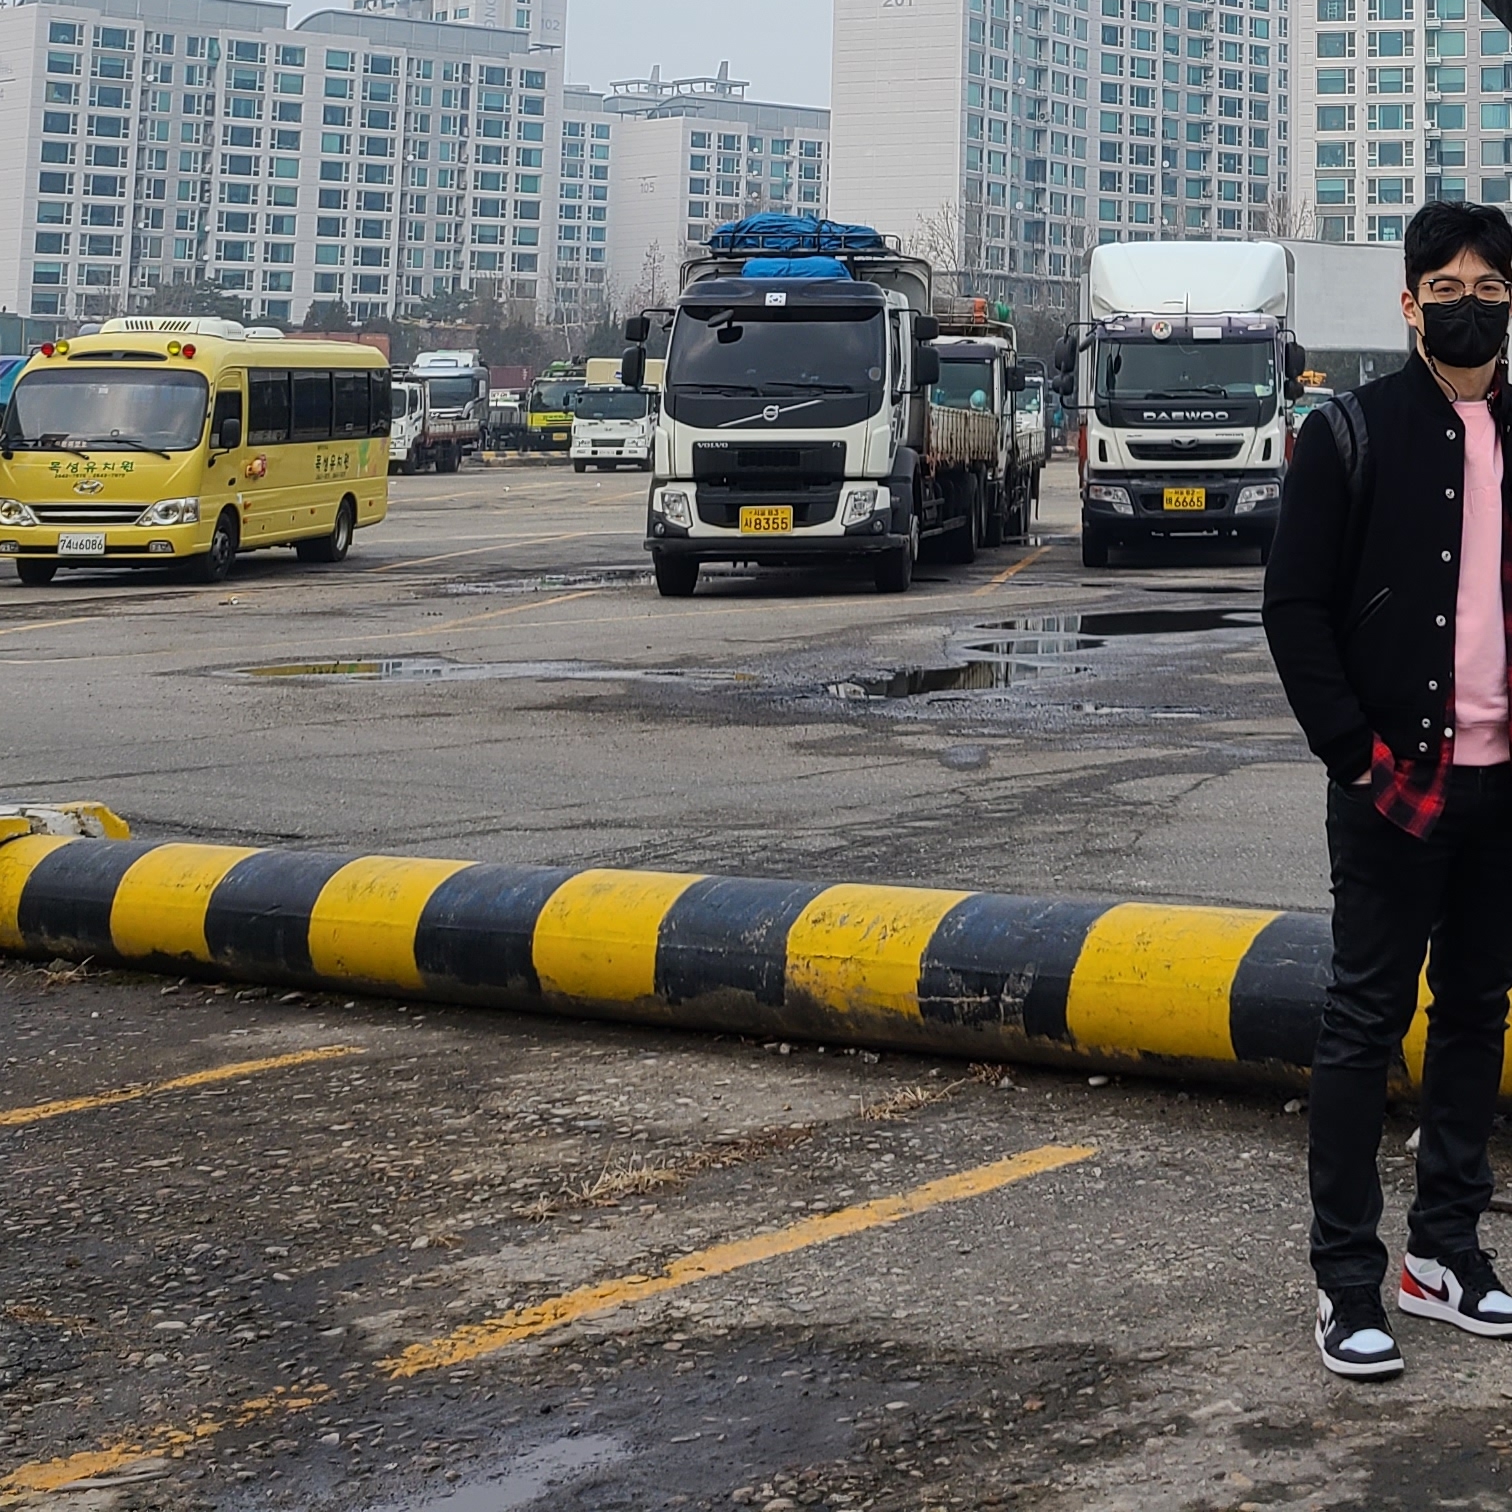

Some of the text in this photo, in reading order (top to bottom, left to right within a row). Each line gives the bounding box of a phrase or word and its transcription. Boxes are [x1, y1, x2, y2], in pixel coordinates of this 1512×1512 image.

[541, 18, 561, 31] 102
[1143, 411, 1229, 421] DAEWOO
[743, 517, 789, 531] 사8355
